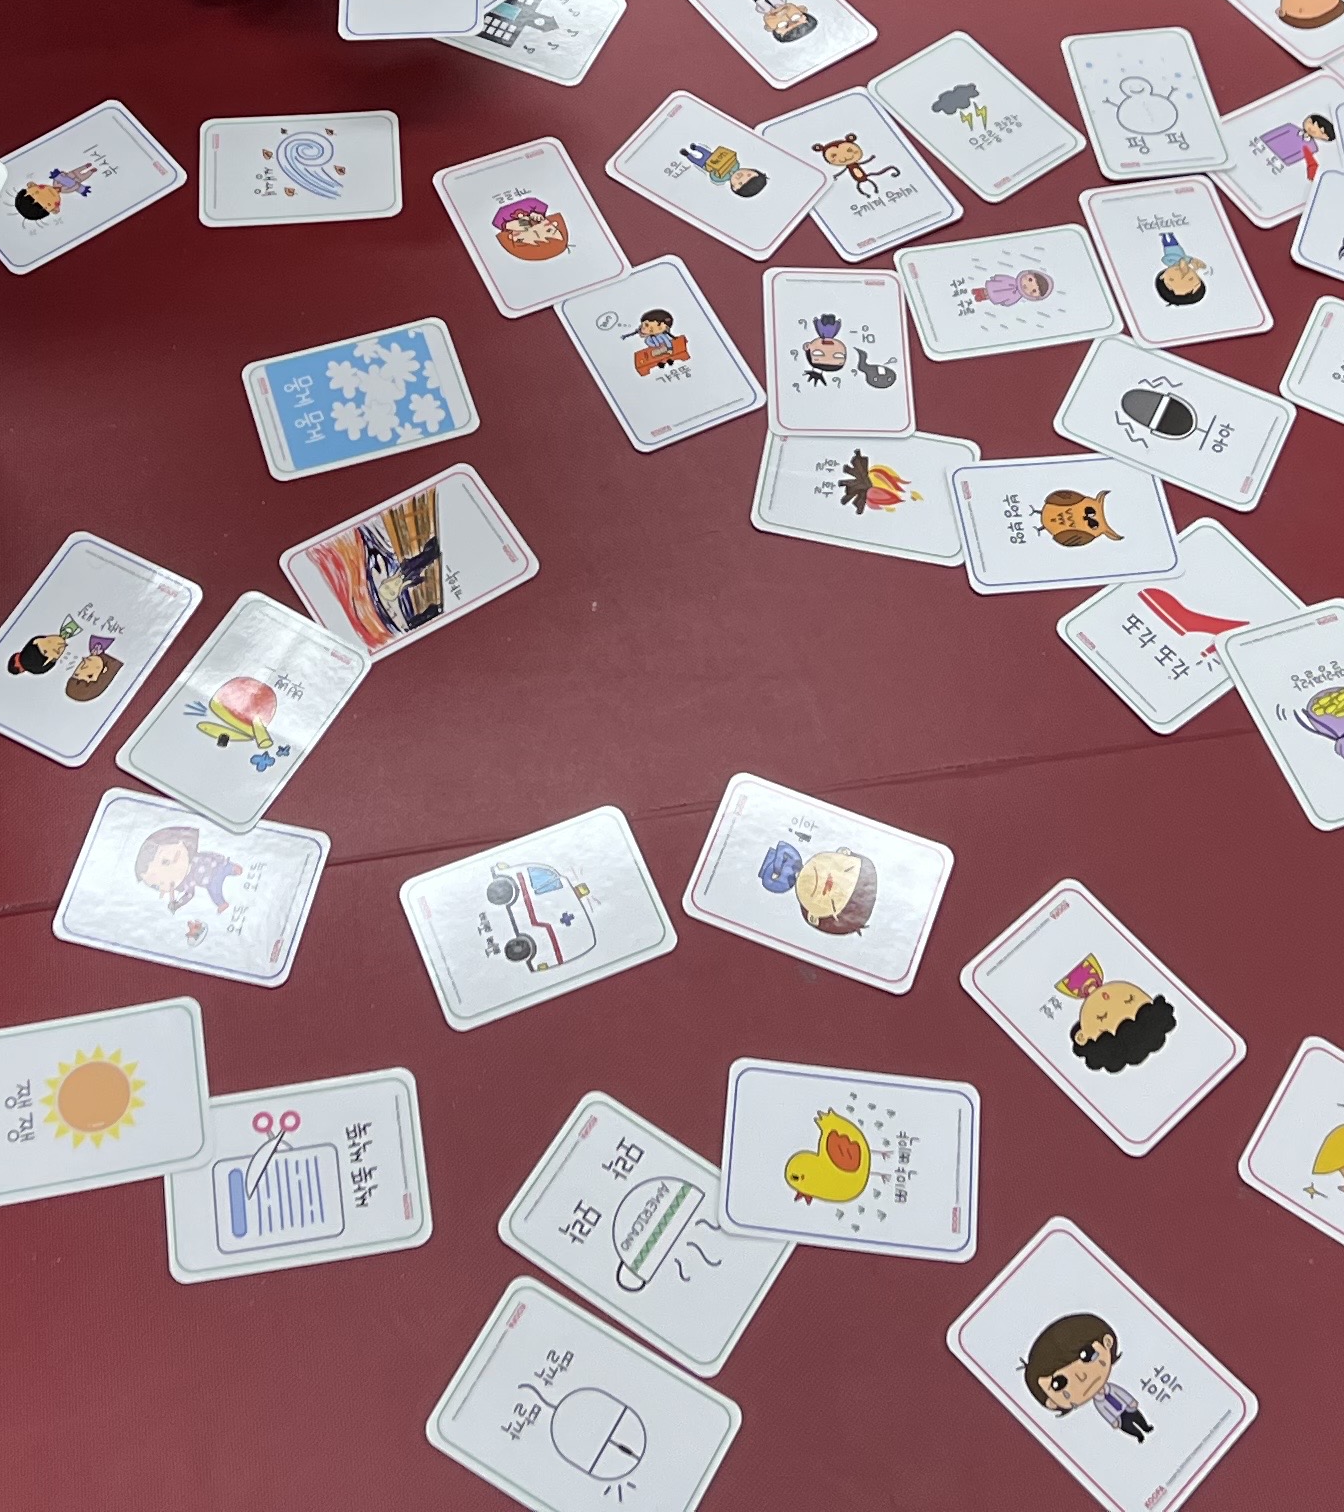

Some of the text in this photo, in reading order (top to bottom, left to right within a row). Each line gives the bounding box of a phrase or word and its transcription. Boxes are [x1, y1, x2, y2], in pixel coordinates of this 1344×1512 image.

[284, 376, 325, 443] 뭉게 뭉게
[1003, 494, 1026, 544] 부엉 부엉
[1122, 614, 1157, 648] 또각
[1154, 645, 1199, 680] 또각
[346, 1123, 378, 1207] 싹뚝 싹뚝
[559, 1137, 644, 1244] 모락 모락
[620, 1181, 669, 1251] AMERICANO
[501, 1350, 574, 1440] 딸깍 딸깍
